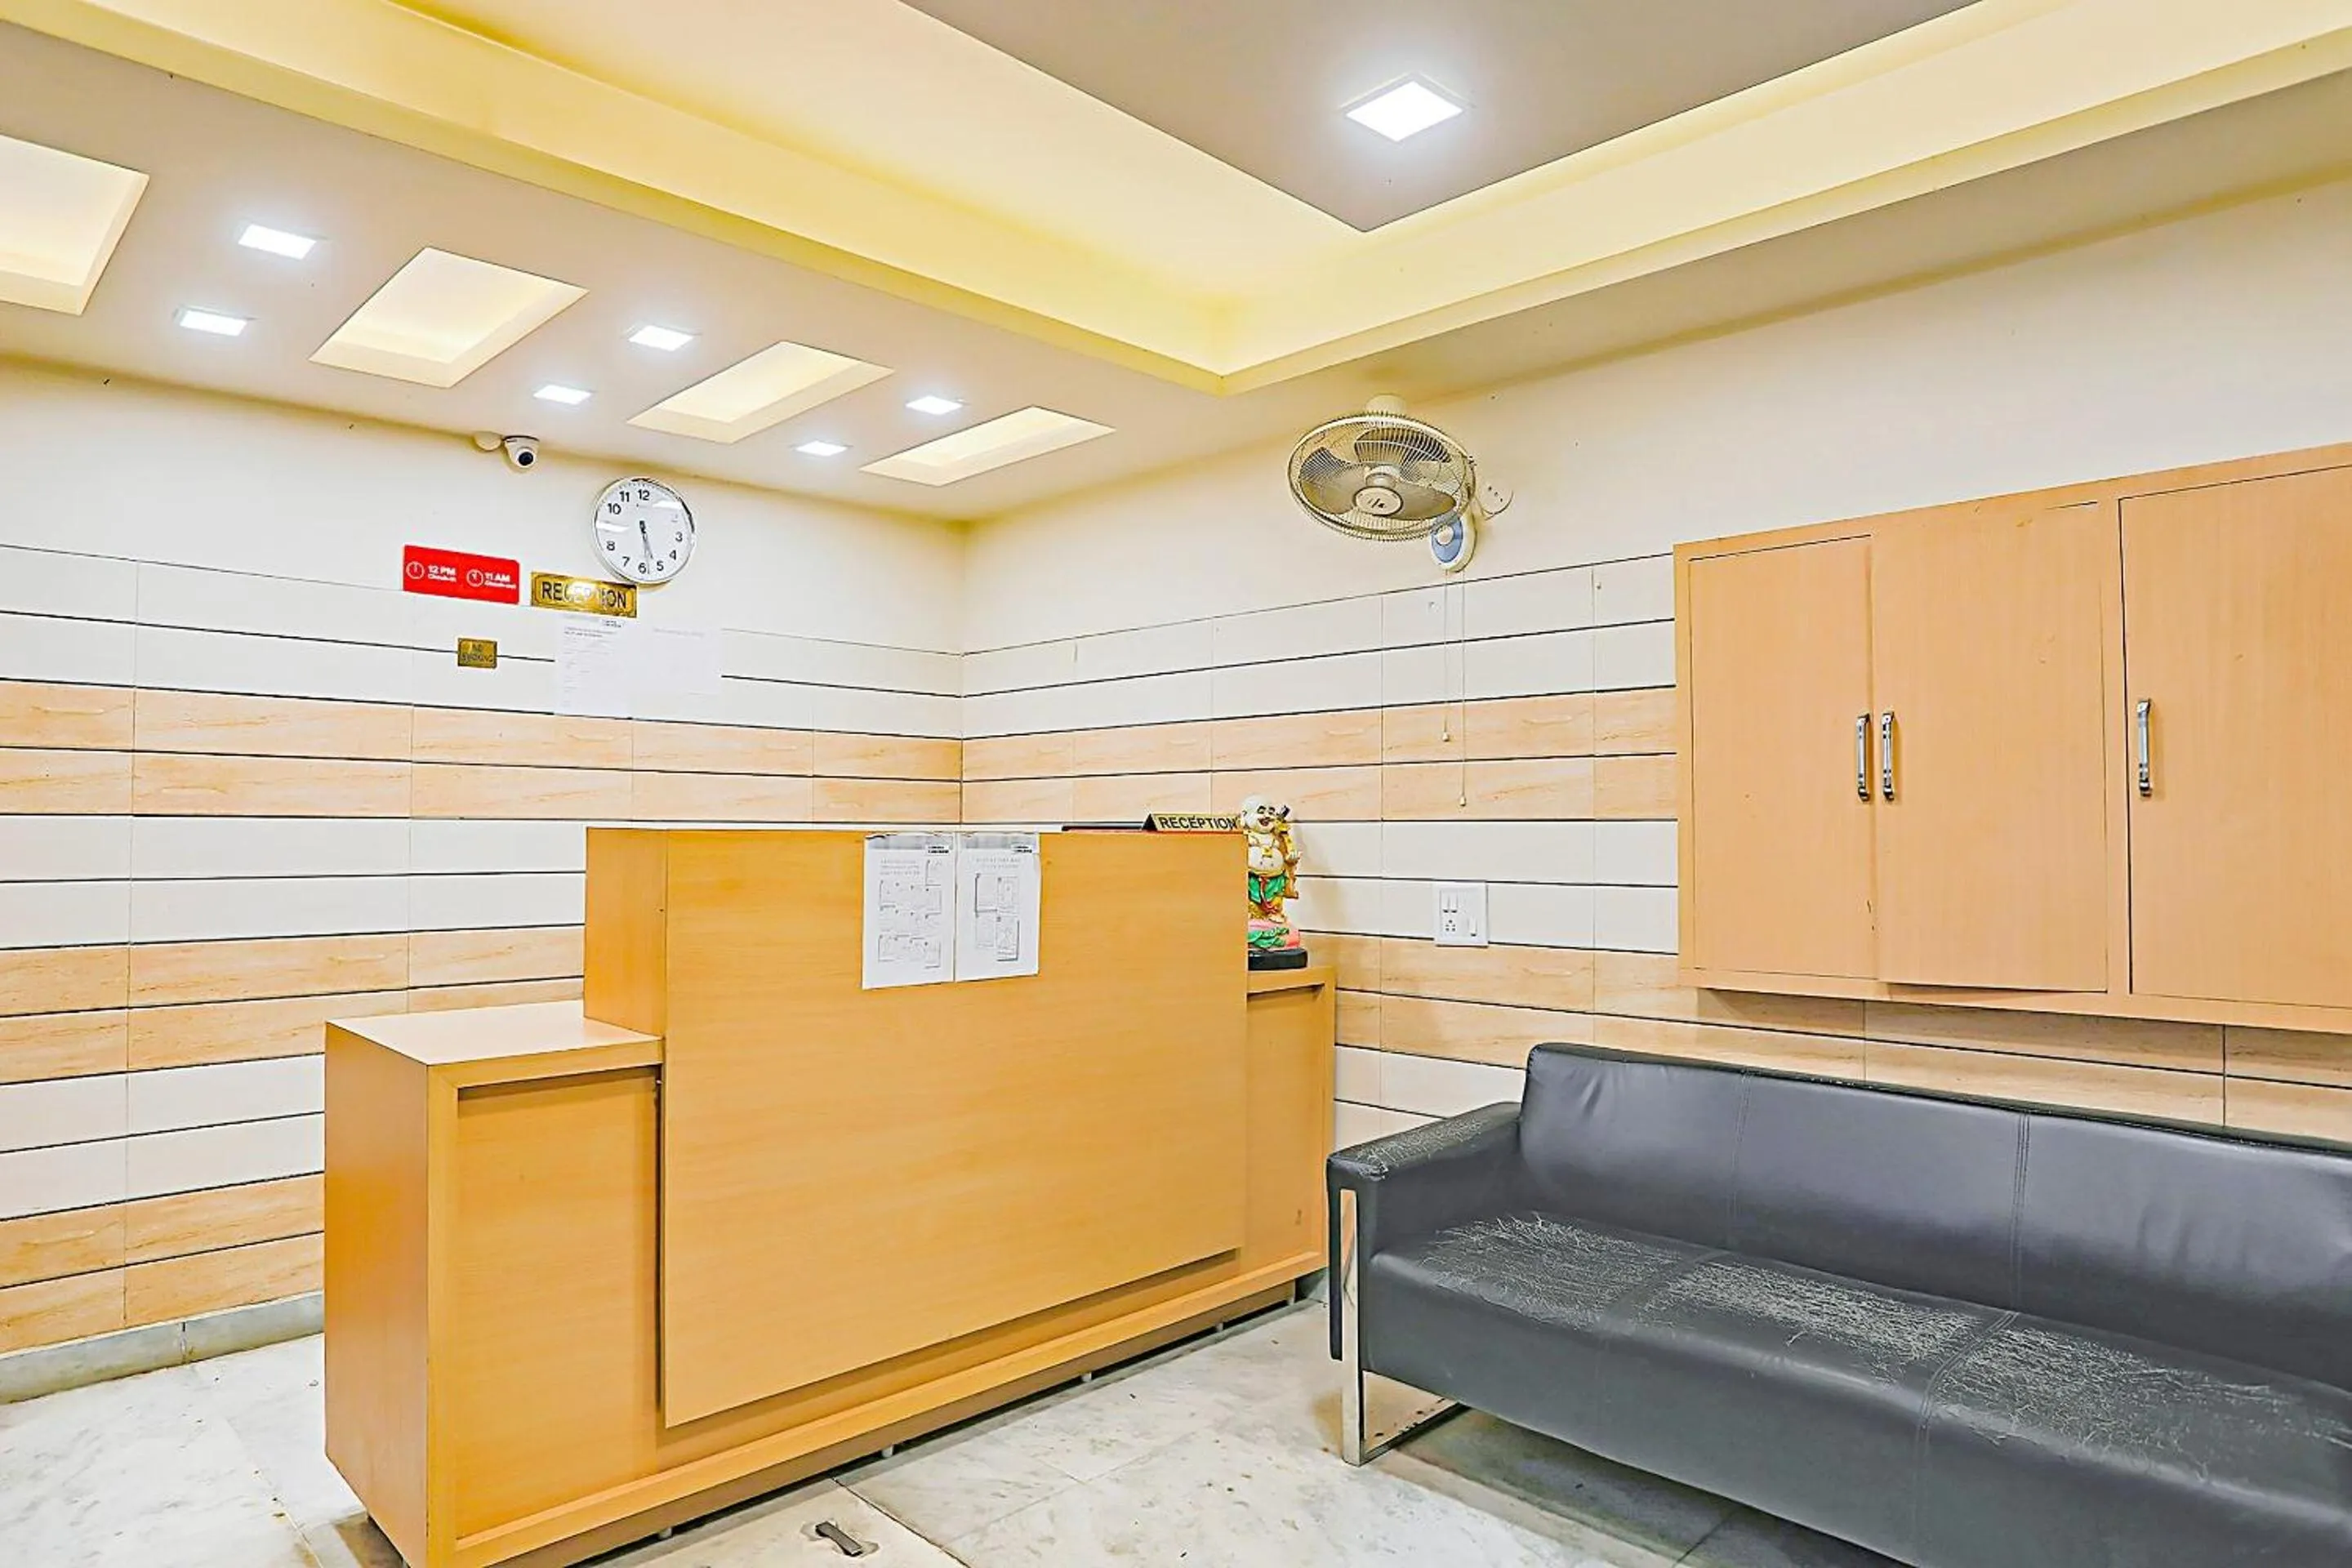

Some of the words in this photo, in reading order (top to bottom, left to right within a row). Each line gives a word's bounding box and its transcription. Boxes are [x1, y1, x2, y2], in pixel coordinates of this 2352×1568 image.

[619, 491, 630, 502] 11
[638, 488, 650, 501] 12
[608, 503, 621, 514] 10
[675, 531, 683, 542] 3
[606, 541, 615, 551] 8
[669, 550, 677, 560] 4
[621, 556, 630, 567] 7
[656, 560, 664, 571] 5
[428, 564, 439, 574] 12
[440, 566, 456, 576] PM
[638, 562, 646, 573] 6
[495, 573, 510, 583] AM
[1158, 816, 1237, 830] RECEPTION
